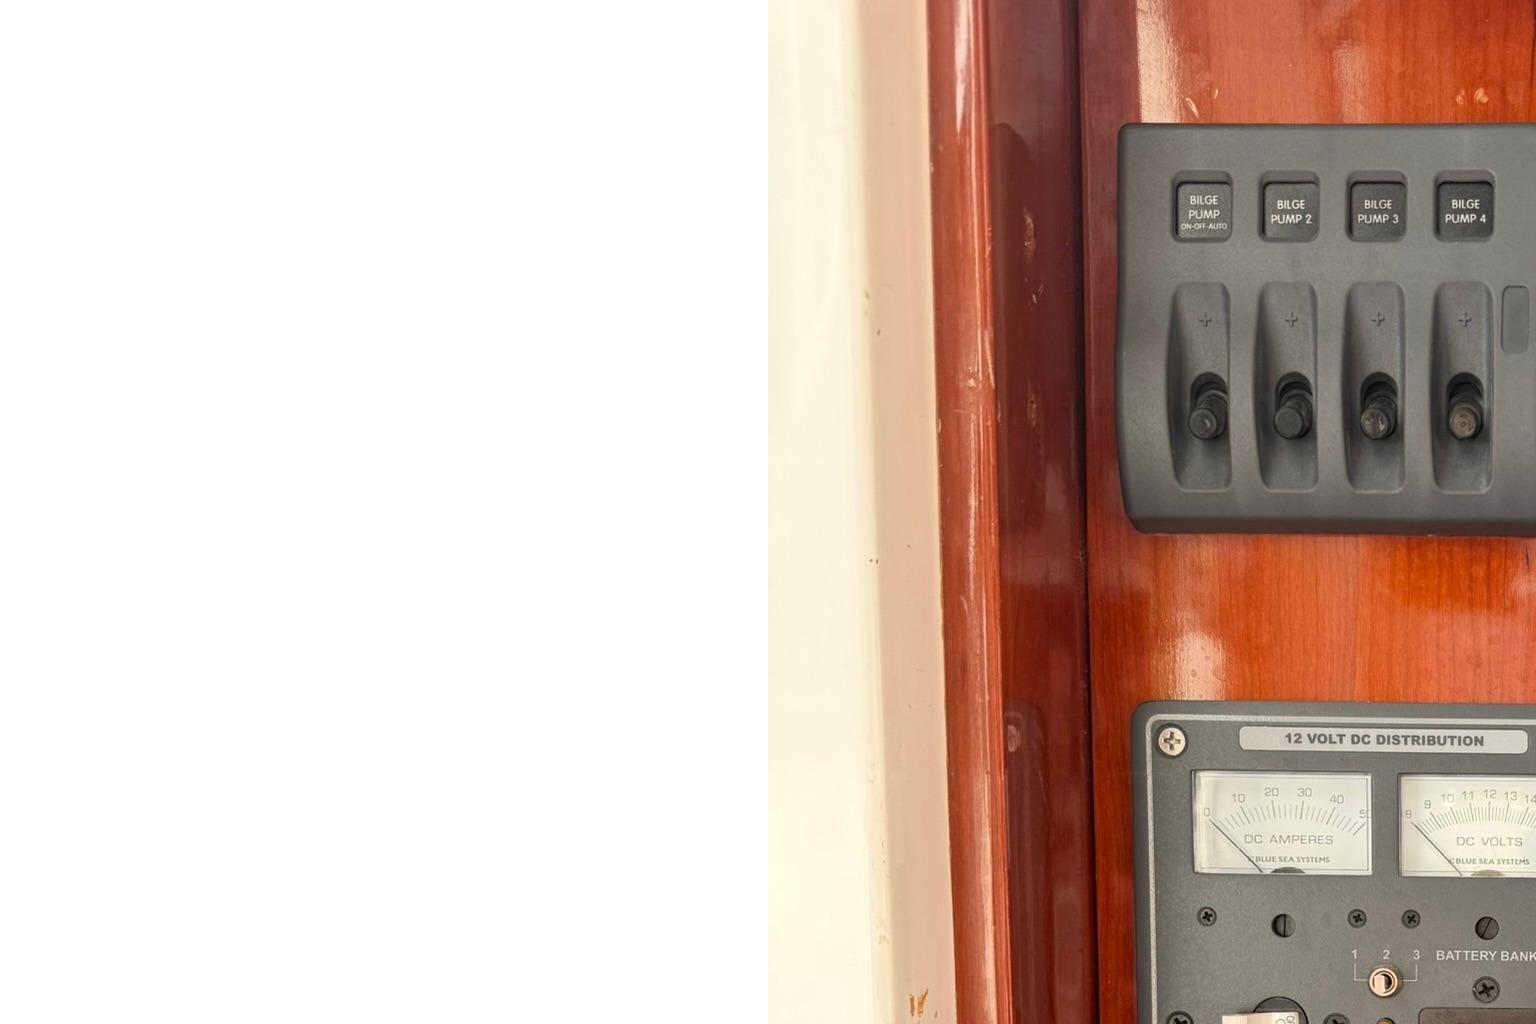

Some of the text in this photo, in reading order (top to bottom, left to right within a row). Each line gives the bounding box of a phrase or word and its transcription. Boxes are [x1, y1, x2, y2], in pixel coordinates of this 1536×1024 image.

[1190, 195, 1218, 205] BILGE
[1277, 199, 1305, 210] BILGE
[1364, 199, 1392, 210] BILGE
[1451, 199, 1480, 210] BILGE
[1188, 210, 1220, 220] PUMP
[1270, 213, 1312, 225] PUMP 2
[1357, 213, 1399, 224] PUMP 3
[1445, 213, 1486, 224] PUMP 4
[1180, 222, 1227, 230] ON-OFF-AUTO
[1285, 733, 1485, 747] 12 VOLT DC DISTRIBUTION
[1264, 788, 1279, 797] 20
[1298, 788, 1312, 797] 30
[1463, 791, 1474, 800] 11
[1484, 790, 1497, 799] 12
[1504, 792, 1517, 800] 13
[1232, 794, 1245, 803] 10
[1330, 795, 1344, 804] 40
[1442, 794, 1454, 803] 10
[1524, 795, 1536, 804] 14
[1424, 800, 1431, 809] 9
[1204, 808, 1210, 817] 0
[1244, 834, 1333, 845] DC AMPERES
[1457, 837, 1523, 846] DC VOLTS
[1352, 950, 1420, 960] 1 2 3
[1436, 950, 1497, 961] BATTERY
